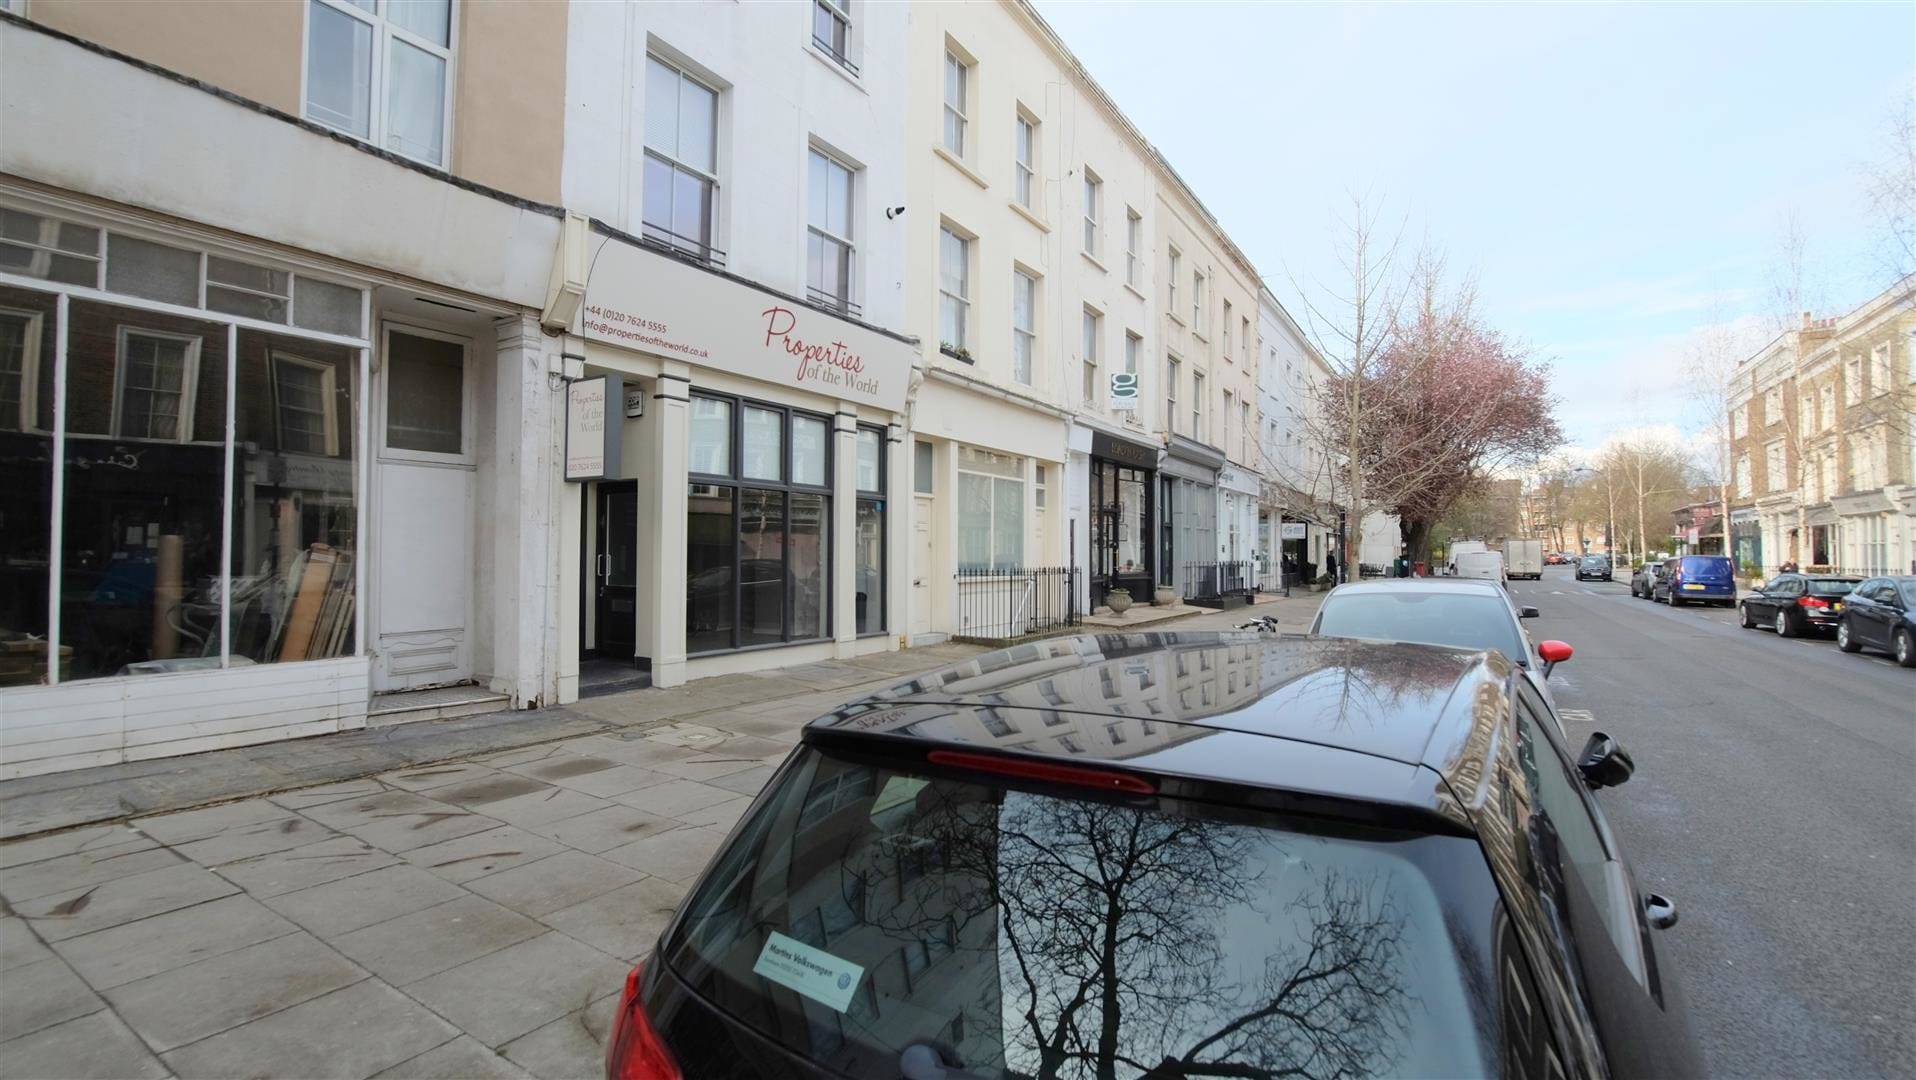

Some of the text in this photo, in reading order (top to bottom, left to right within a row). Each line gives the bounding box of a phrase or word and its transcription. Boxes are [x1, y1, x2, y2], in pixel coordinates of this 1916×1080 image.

[585, 305, 667, 334] +44 (0)20 7624 5555
[583, 320, 709, 358] nfo@propertiesoftheworld.co.uk
[761, 306, 865, 381] Properties
[806, 363, 879, 395] of the World
[591, 407, 603, 418] the
[580, 423, 603, 433] World
[793, 952, 833, 977] Volkswagen
